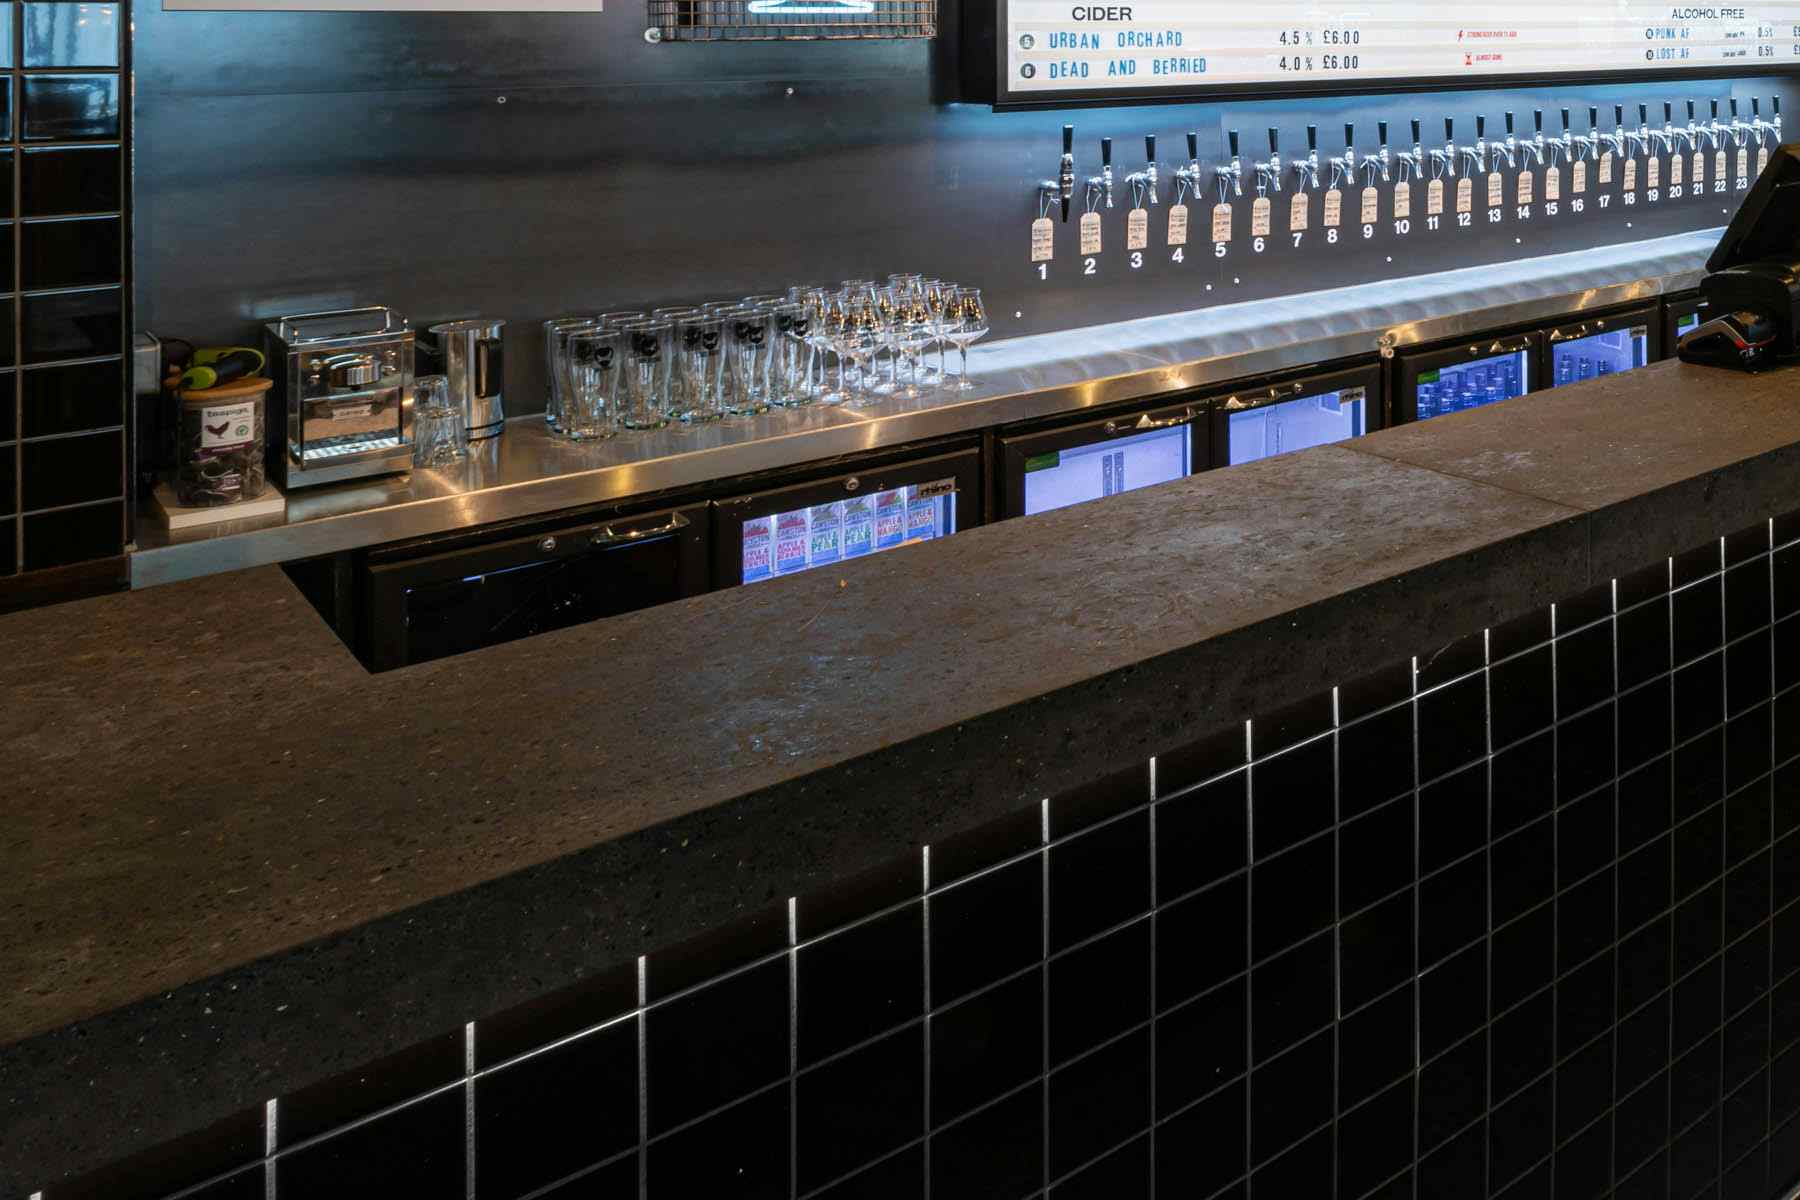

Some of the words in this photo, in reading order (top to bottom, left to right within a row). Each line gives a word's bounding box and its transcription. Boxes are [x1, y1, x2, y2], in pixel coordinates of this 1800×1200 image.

[1072, 6, 1133, 21] CIDER
[1672, 8, 1718, 19] ALCOHOL
[1720, 8, 1744, 19] FREE
[1050, 32, 1100, 49] URBAN
[1118, 31, 1182, 48] ORCHARD
[1323, 30, 1360, 45] £6.00
[1050, 61, 1089, 79] DEAD
[1108, 59, 1136, 76] AND
[1153, 57, 1206, 75] BERRIED
[1323, 54, 1359, 70] £6.00
[1692, 182, 1704, 195] 21
[1714, 180, 1727, 192] 22
[1735, 178, 1748, 190] 23
[1623, 192, 1636, 205] 18
[1647, 189, 1659, 201] 19
[1669, 185, 1682, 198] 20
[1544, 202, 1558, 215] 15
[1571, 199, 1584, 212] 16
[1599, 195, 1610, 208] 17
[1457, 212, 1471, 226] 12
[1487, 209, 1502, 223] 13
[1517, 206, 1531, 219] 14
[1393, 220, 1409, 234] 10
[1427, 217, 1439, 230] 11
[1327, 228, 1338, 243] 8
[1362, 224, 1373, 238] 9
[1253, 237, 1265, 252] 6
[1292, 232, 1302, 247] 7
[1172, 247, 1184, 263] 4
[1215, 242, 1226, 257] 5
[1084, 257, 1096, 275] 2
[1130, 252, 1142, 268] 3
[1038, 263, 1046, 280] 1
